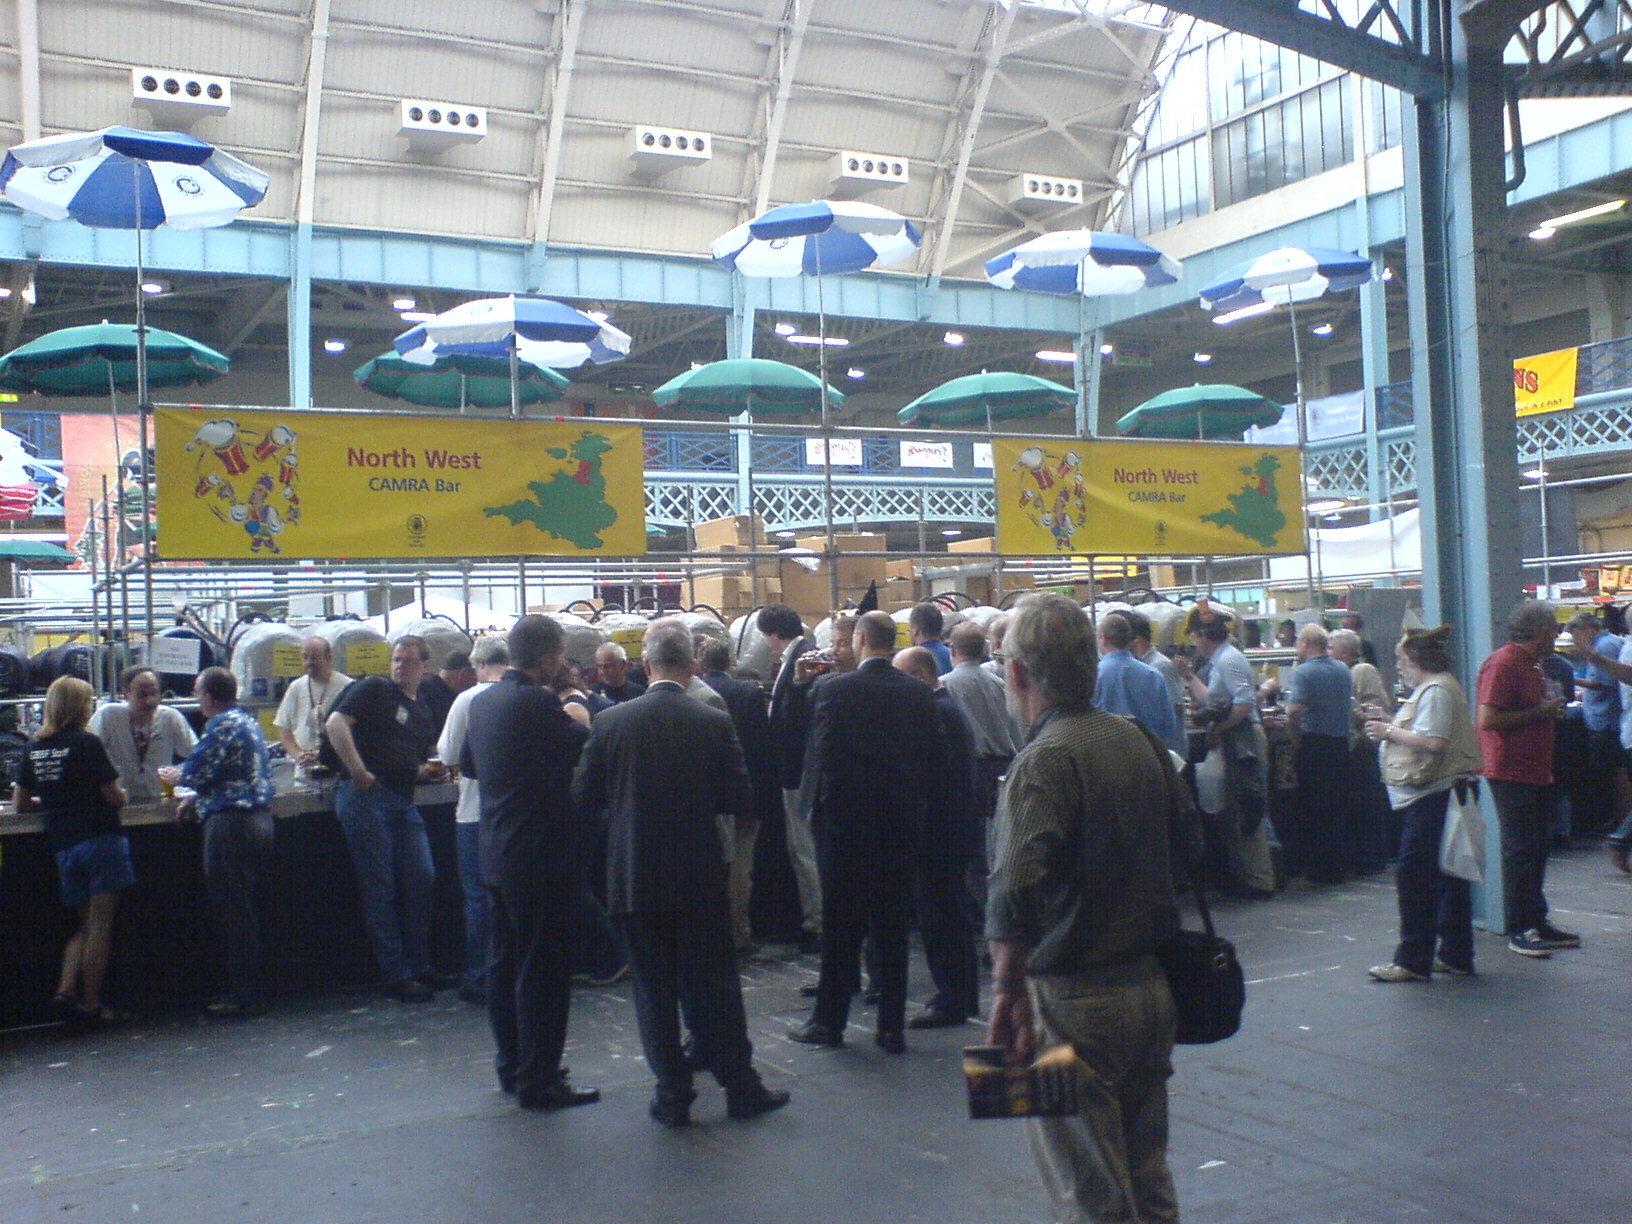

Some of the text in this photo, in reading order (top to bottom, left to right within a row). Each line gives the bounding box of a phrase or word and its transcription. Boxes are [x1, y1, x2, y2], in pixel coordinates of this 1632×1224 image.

[347, 447, 482, 470] North West
[1114, 468, 1198, 484] North West
[369, 477, 461, 492] CAMRA Bar
[1128, 491, 1186, 503] CAMRA Bar
